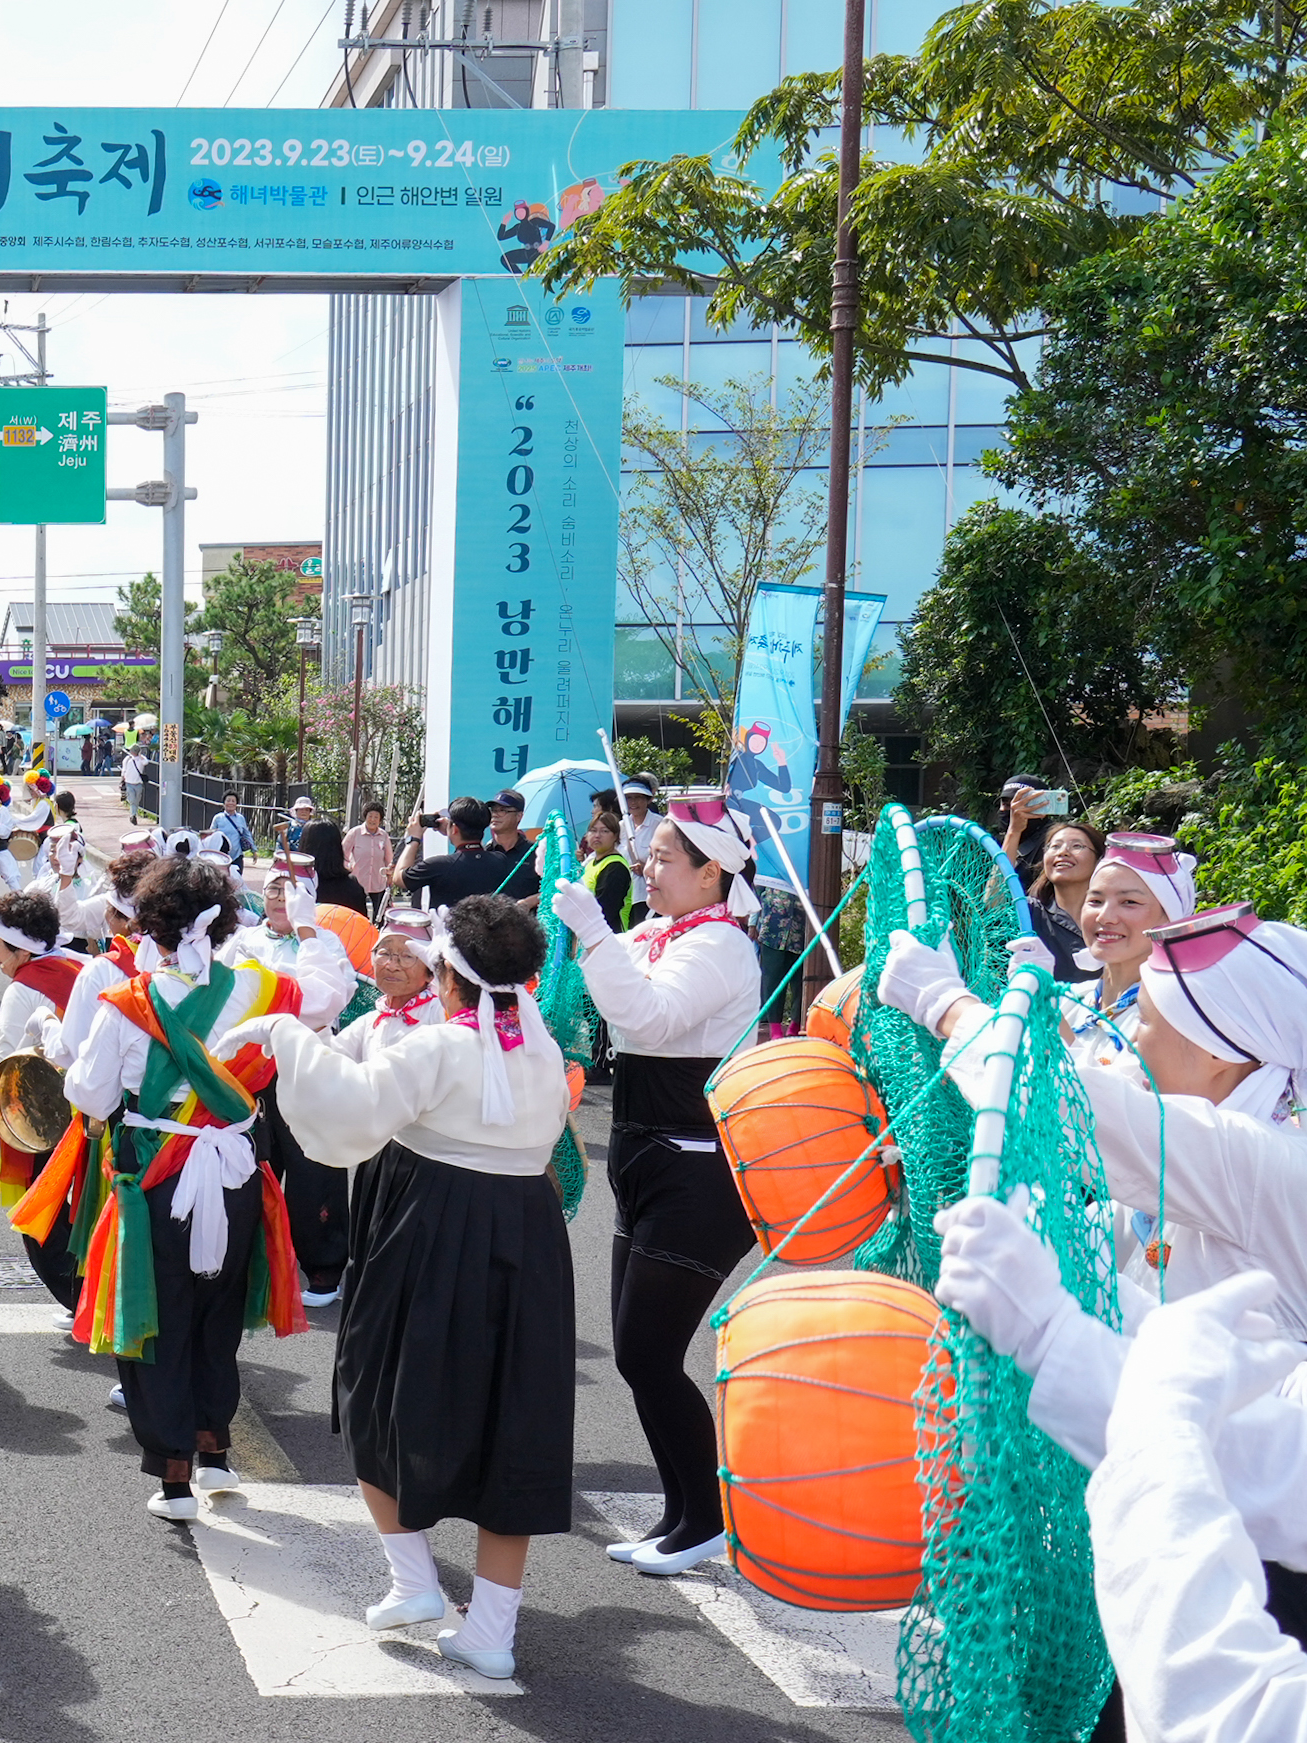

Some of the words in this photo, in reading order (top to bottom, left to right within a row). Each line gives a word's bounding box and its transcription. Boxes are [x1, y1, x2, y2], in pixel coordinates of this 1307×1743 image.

[229, 184, 328, 209] 해녀박물관
[357, 186, 395, 208] 인근
[400, 186, 459, 208] 해안변
[464, 186, 504, 208] 일원
[369, 238, 454, 251] 제주어류양식수협
[538, 364, 561, 372] APEC
[9, 415, 38, 425] 서(W)
[58, 411, 102, 431] 제주
[5, 429, 35, 443] 1132
[58, 434, 99, 452] 濟州
[561, 419, 579, 468] 천상의
[58, 454, 87, 470] Jeju
[561, 476, 577, 508] 소리
[558, 604, 573, 653] 온누리
[45, 664, 70, 679] CU
[555, 660, 571, 742] 울려퍼지다
